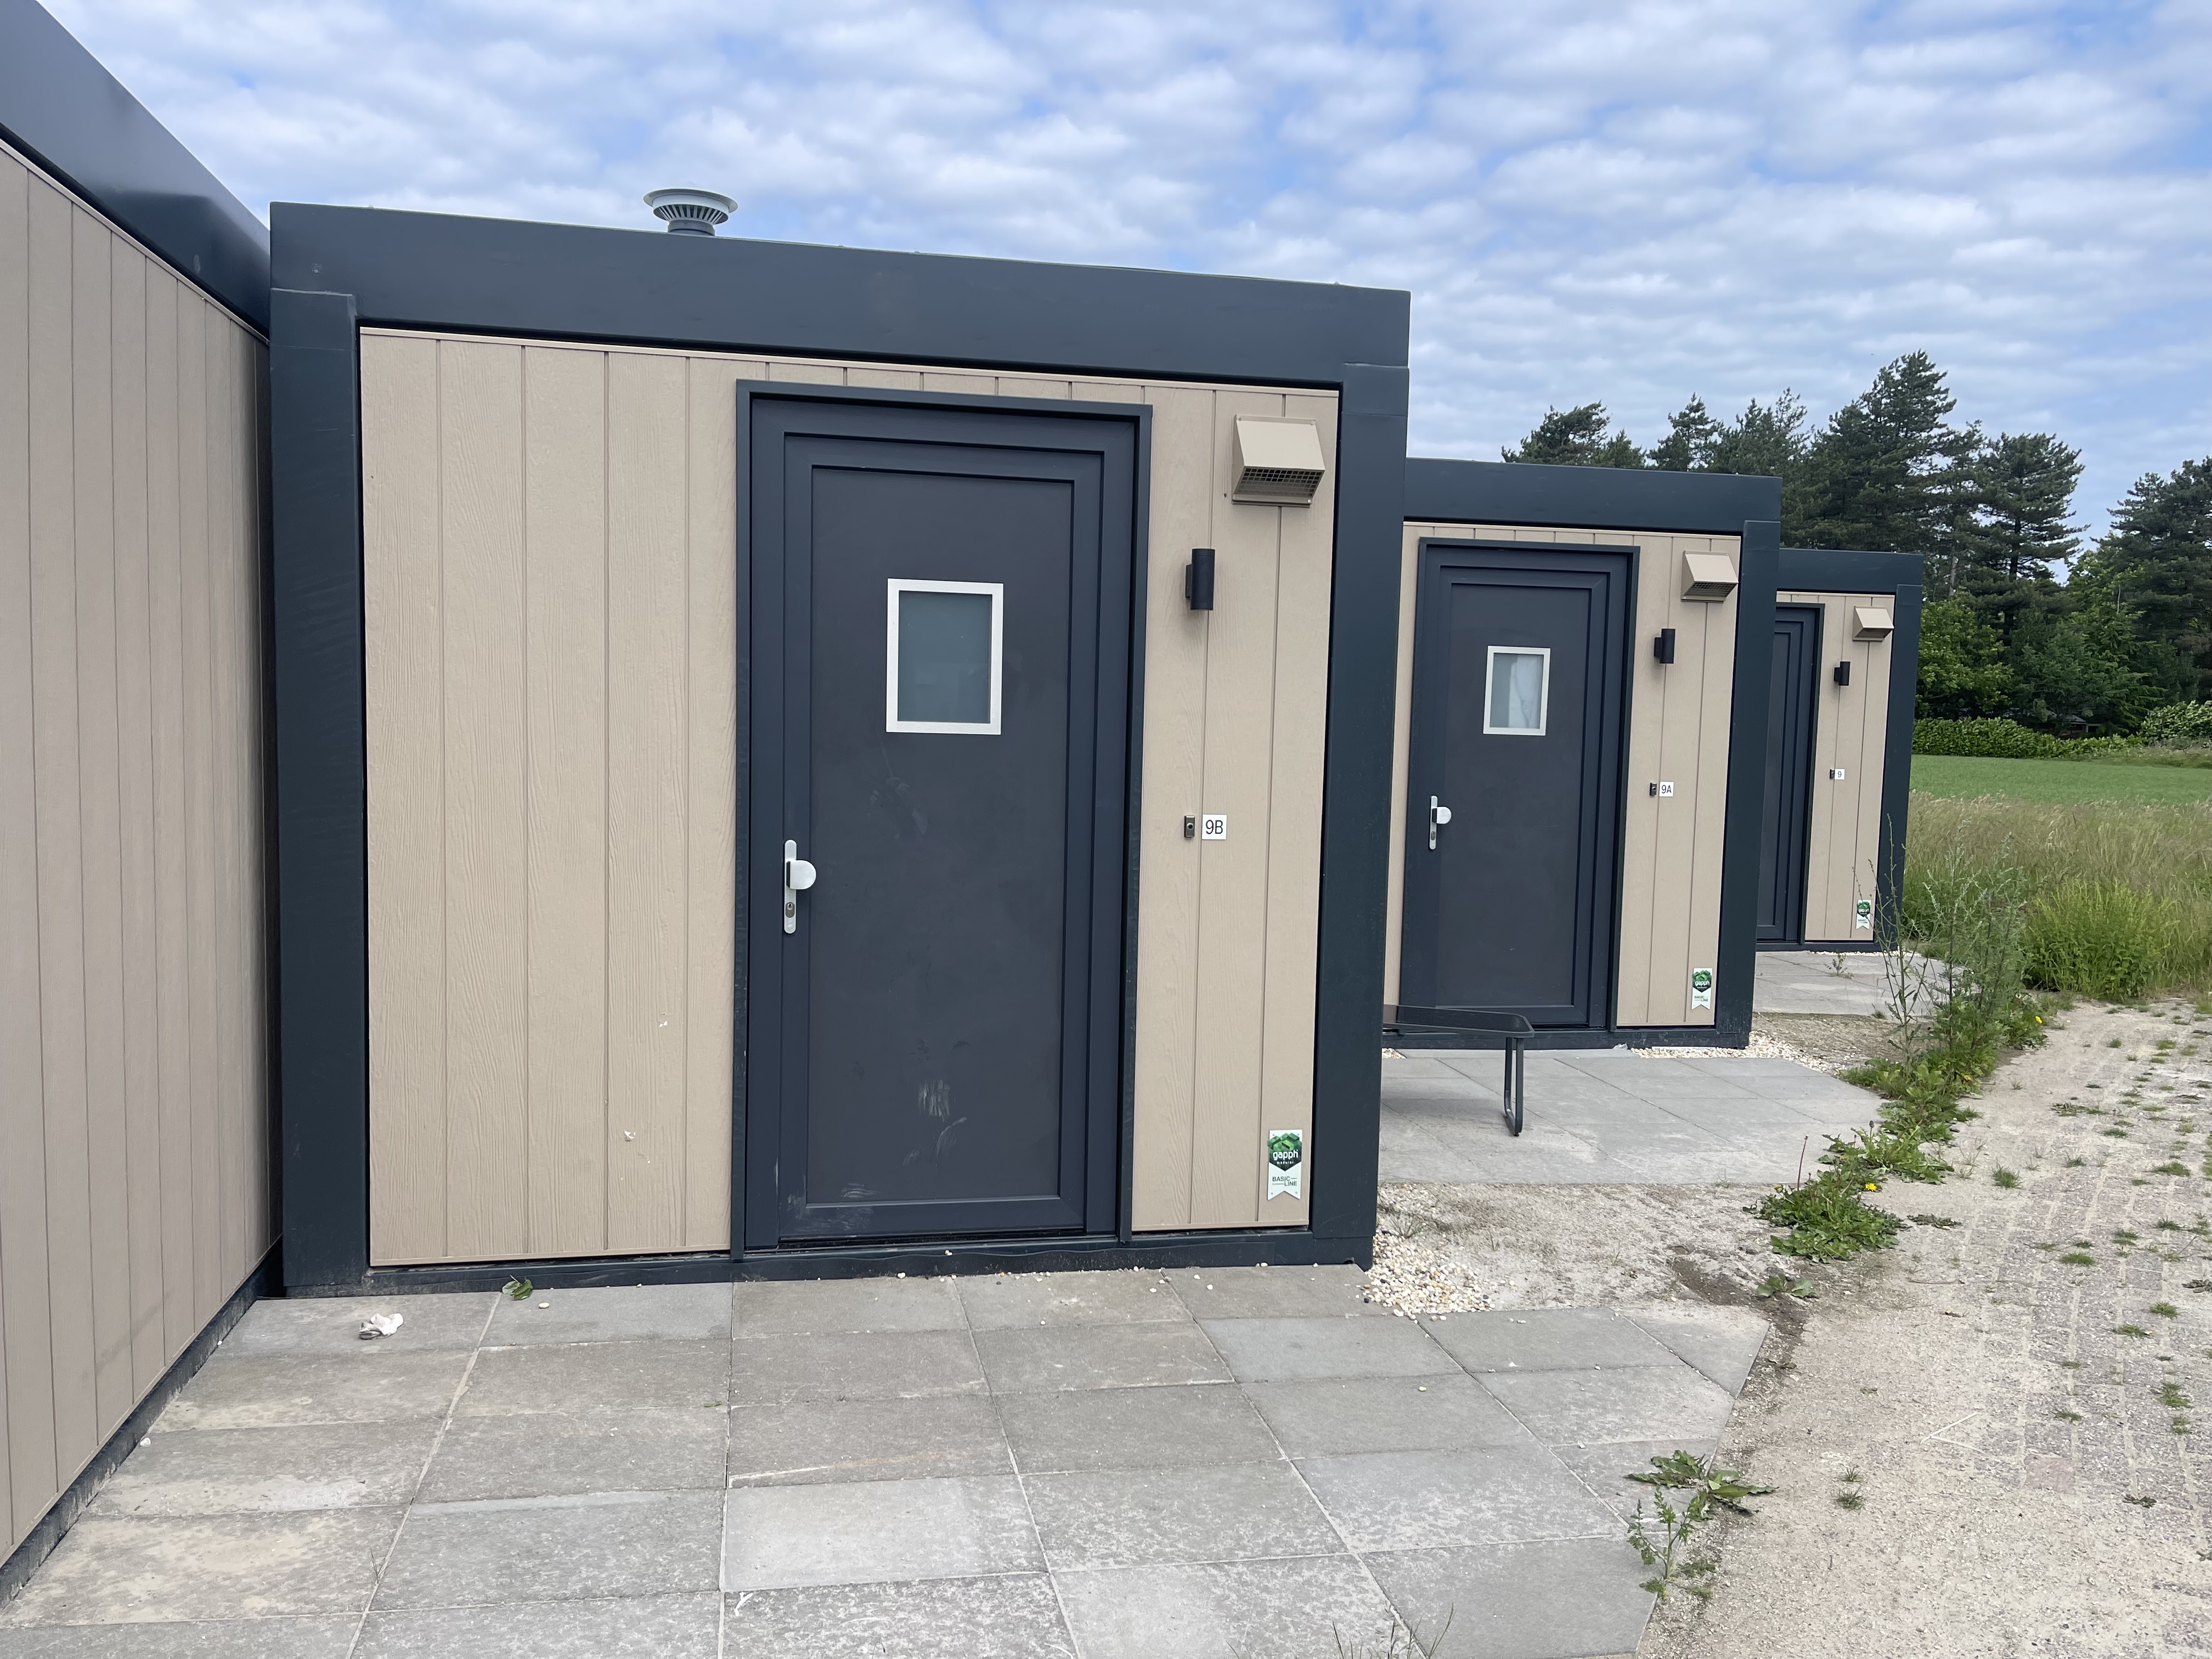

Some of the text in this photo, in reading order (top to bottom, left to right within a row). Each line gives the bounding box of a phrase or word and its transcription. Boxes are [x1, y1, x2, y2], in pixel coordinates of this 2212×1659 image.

[1661, 785, 1672, 794] 9A
[1205, 819, 1223, 834] 9B
[1272, 1149, 1299, 1161] gapph
